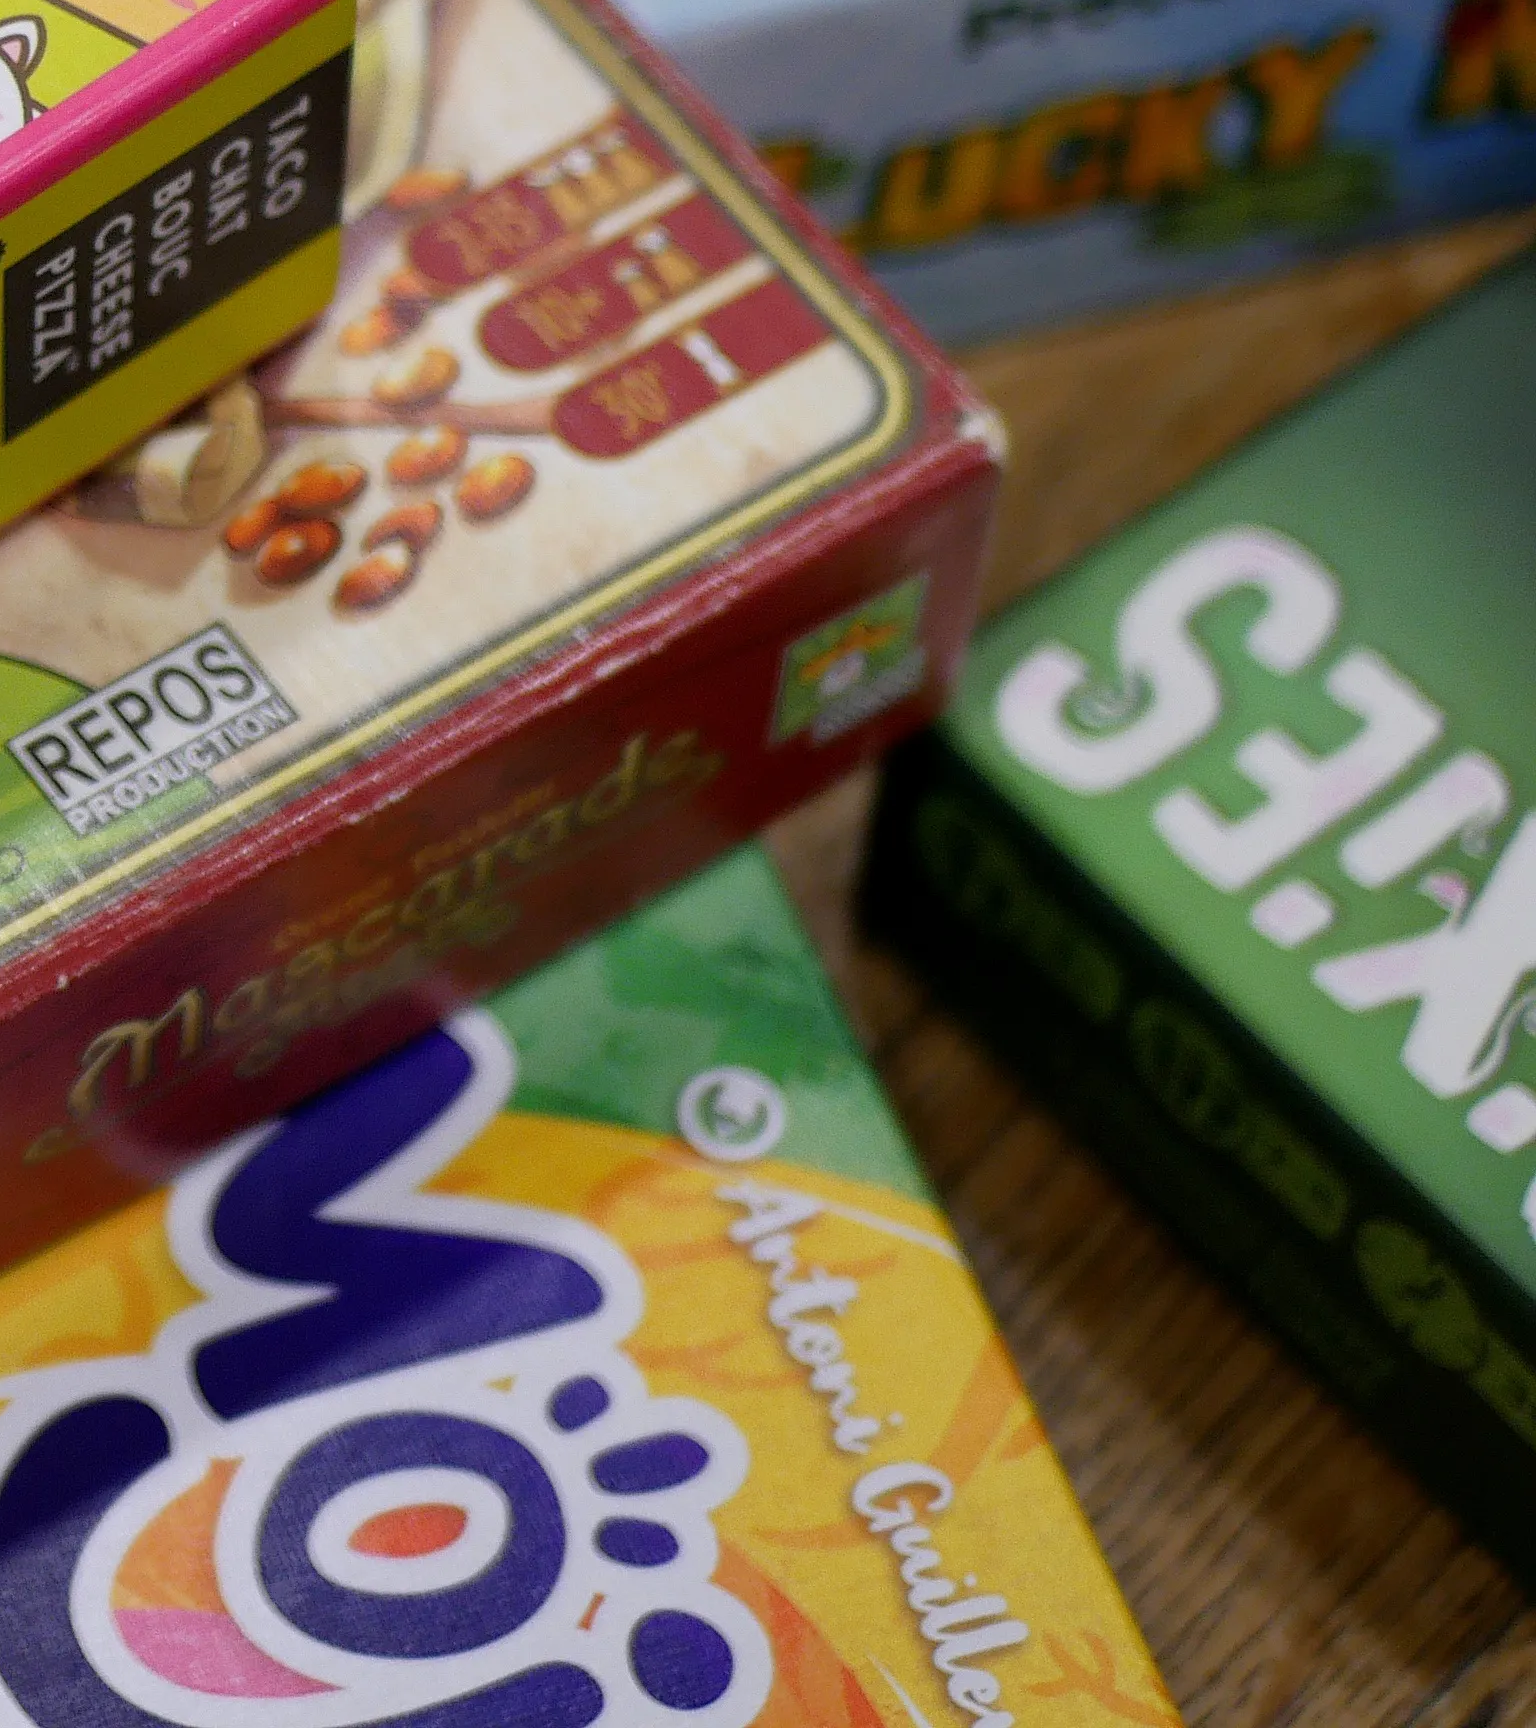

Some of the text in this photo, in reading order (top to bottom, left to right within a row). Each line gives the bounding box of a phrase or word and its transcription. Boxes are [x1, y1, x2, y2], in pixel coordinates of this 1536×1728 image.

[206, 136, 253, 246] CHAT
[262, 94, 313, 220] TACO
[89, 212, 136, 370] CHEESE
[146, 170, 195, 297] BOUC
[31, 245, 78, 385] PIZZA
[25, 642, 256, 800] REPOS
[70, 699, 294, 834] PRODUCTION
[70, 729, 718, 1117] Mascarade
[716, 1175, 904, 1455] Antoni
